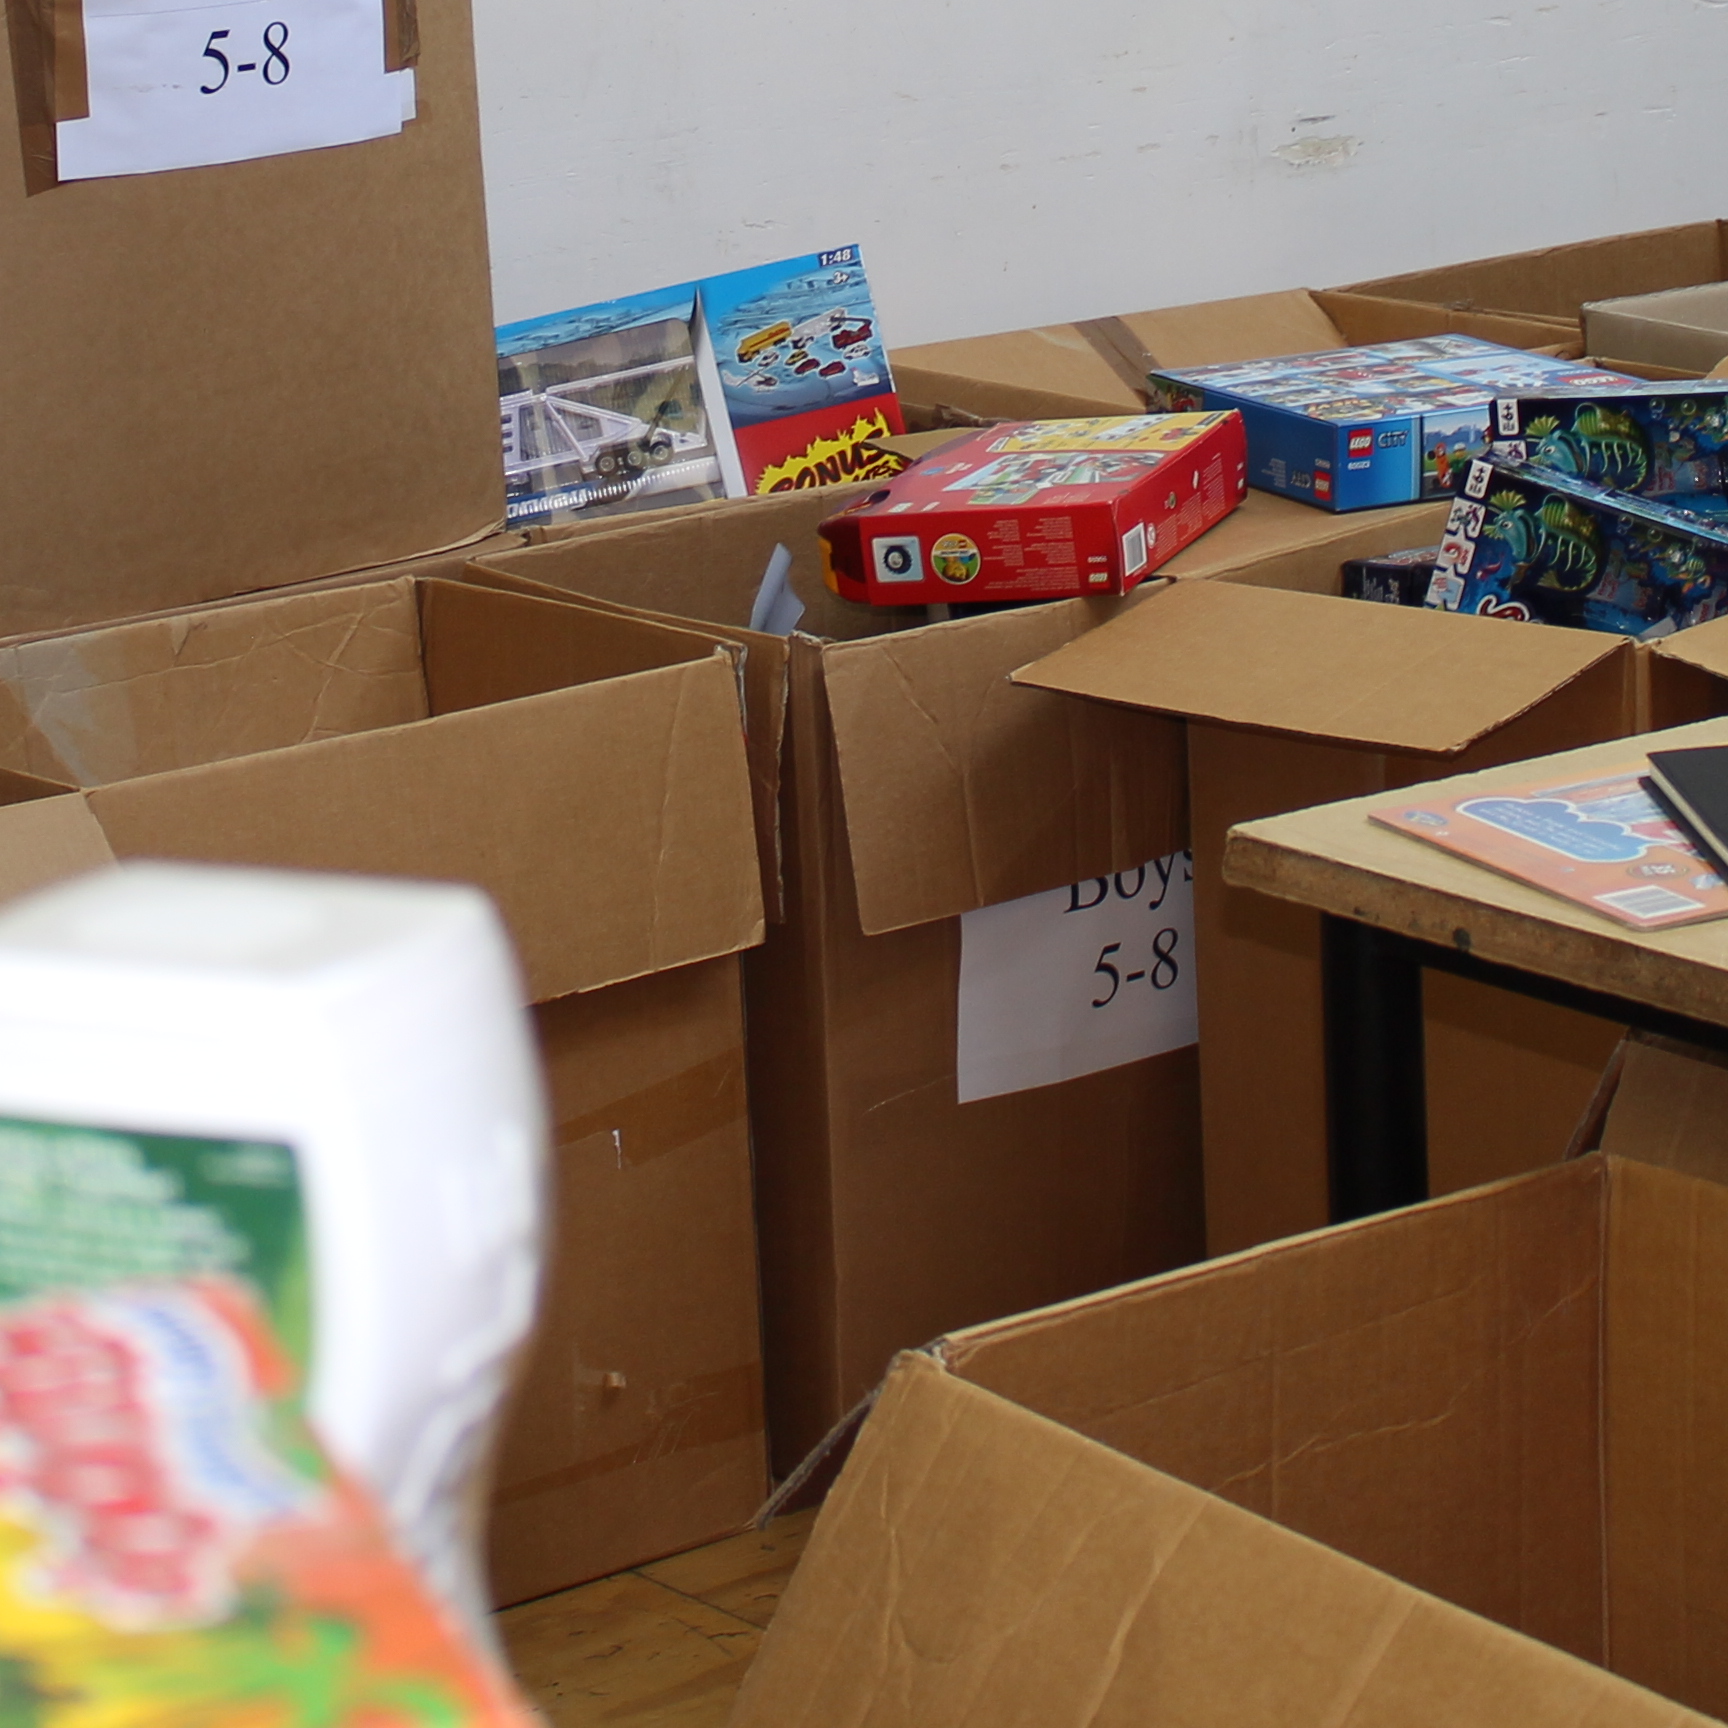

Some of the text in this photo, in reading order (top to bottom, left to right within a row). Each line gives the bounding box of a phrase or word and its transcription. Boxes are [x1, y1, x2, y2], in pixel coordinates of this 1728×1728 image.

[199, 20, 292, 95] 5-8
[819, 248, 852, 266] 1:48
[1348, 429, 1409, 450] LEGO CITY
[1091, 926, 1180, 1009] 5-8
